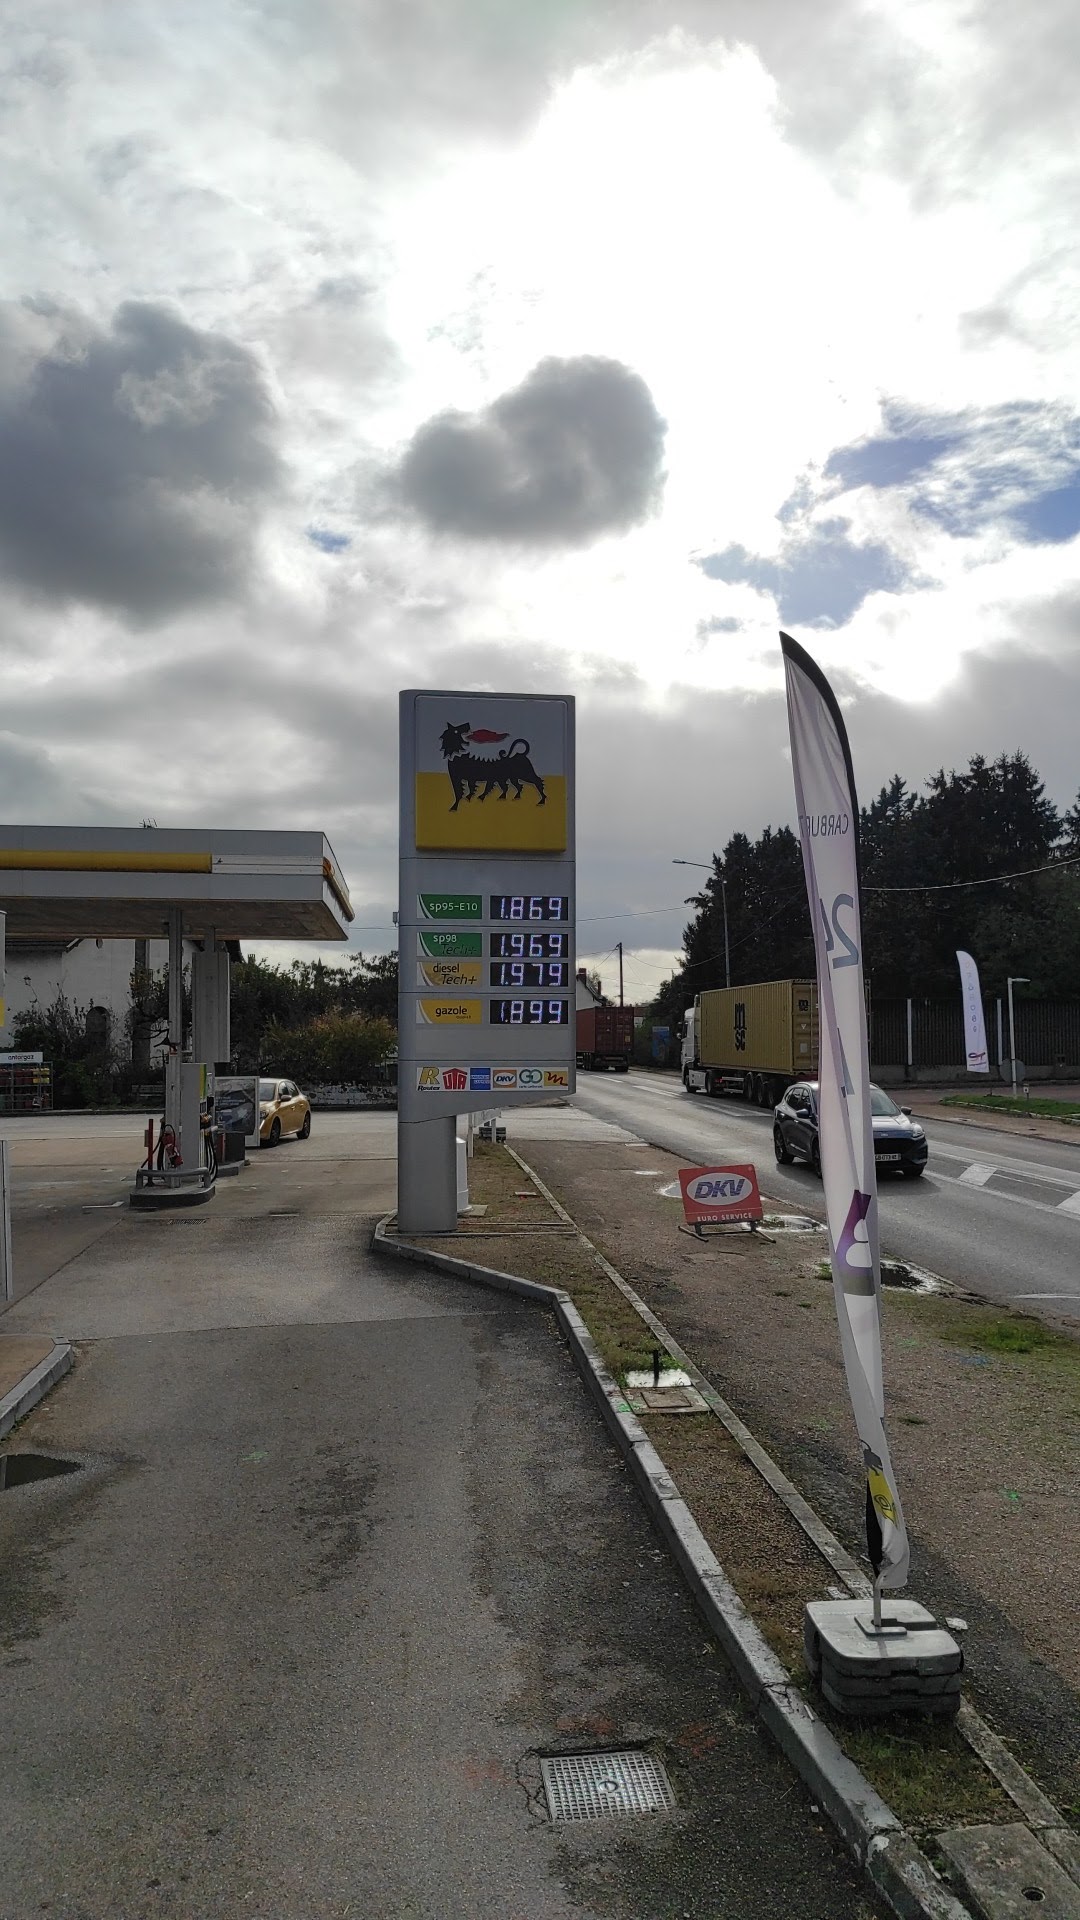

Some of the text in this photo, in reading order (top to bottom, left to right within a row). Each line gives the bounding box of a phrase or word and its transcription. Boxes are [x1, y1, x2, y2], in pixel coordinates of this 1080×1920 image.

[429, 902, 478, 912] sp95-E10
[500, 897, 562, 920] 1.869
[433, 934, 457, 944] sp98
[500, 934, 562, 957] 1.969
[433, 963, 460, 973] diesel
[500, 963, 562, 986] 1.979
[441, 974, 477, 984] Tech+
[435, 1005, 467, 1017] gazole
[500, 1000, 562, 1024] 1.899
[442, 1068, 468, 1090] UTA
[694, 1178, 746, 1199] DKV
[721, 1213, 752, 1221] SERVICE
